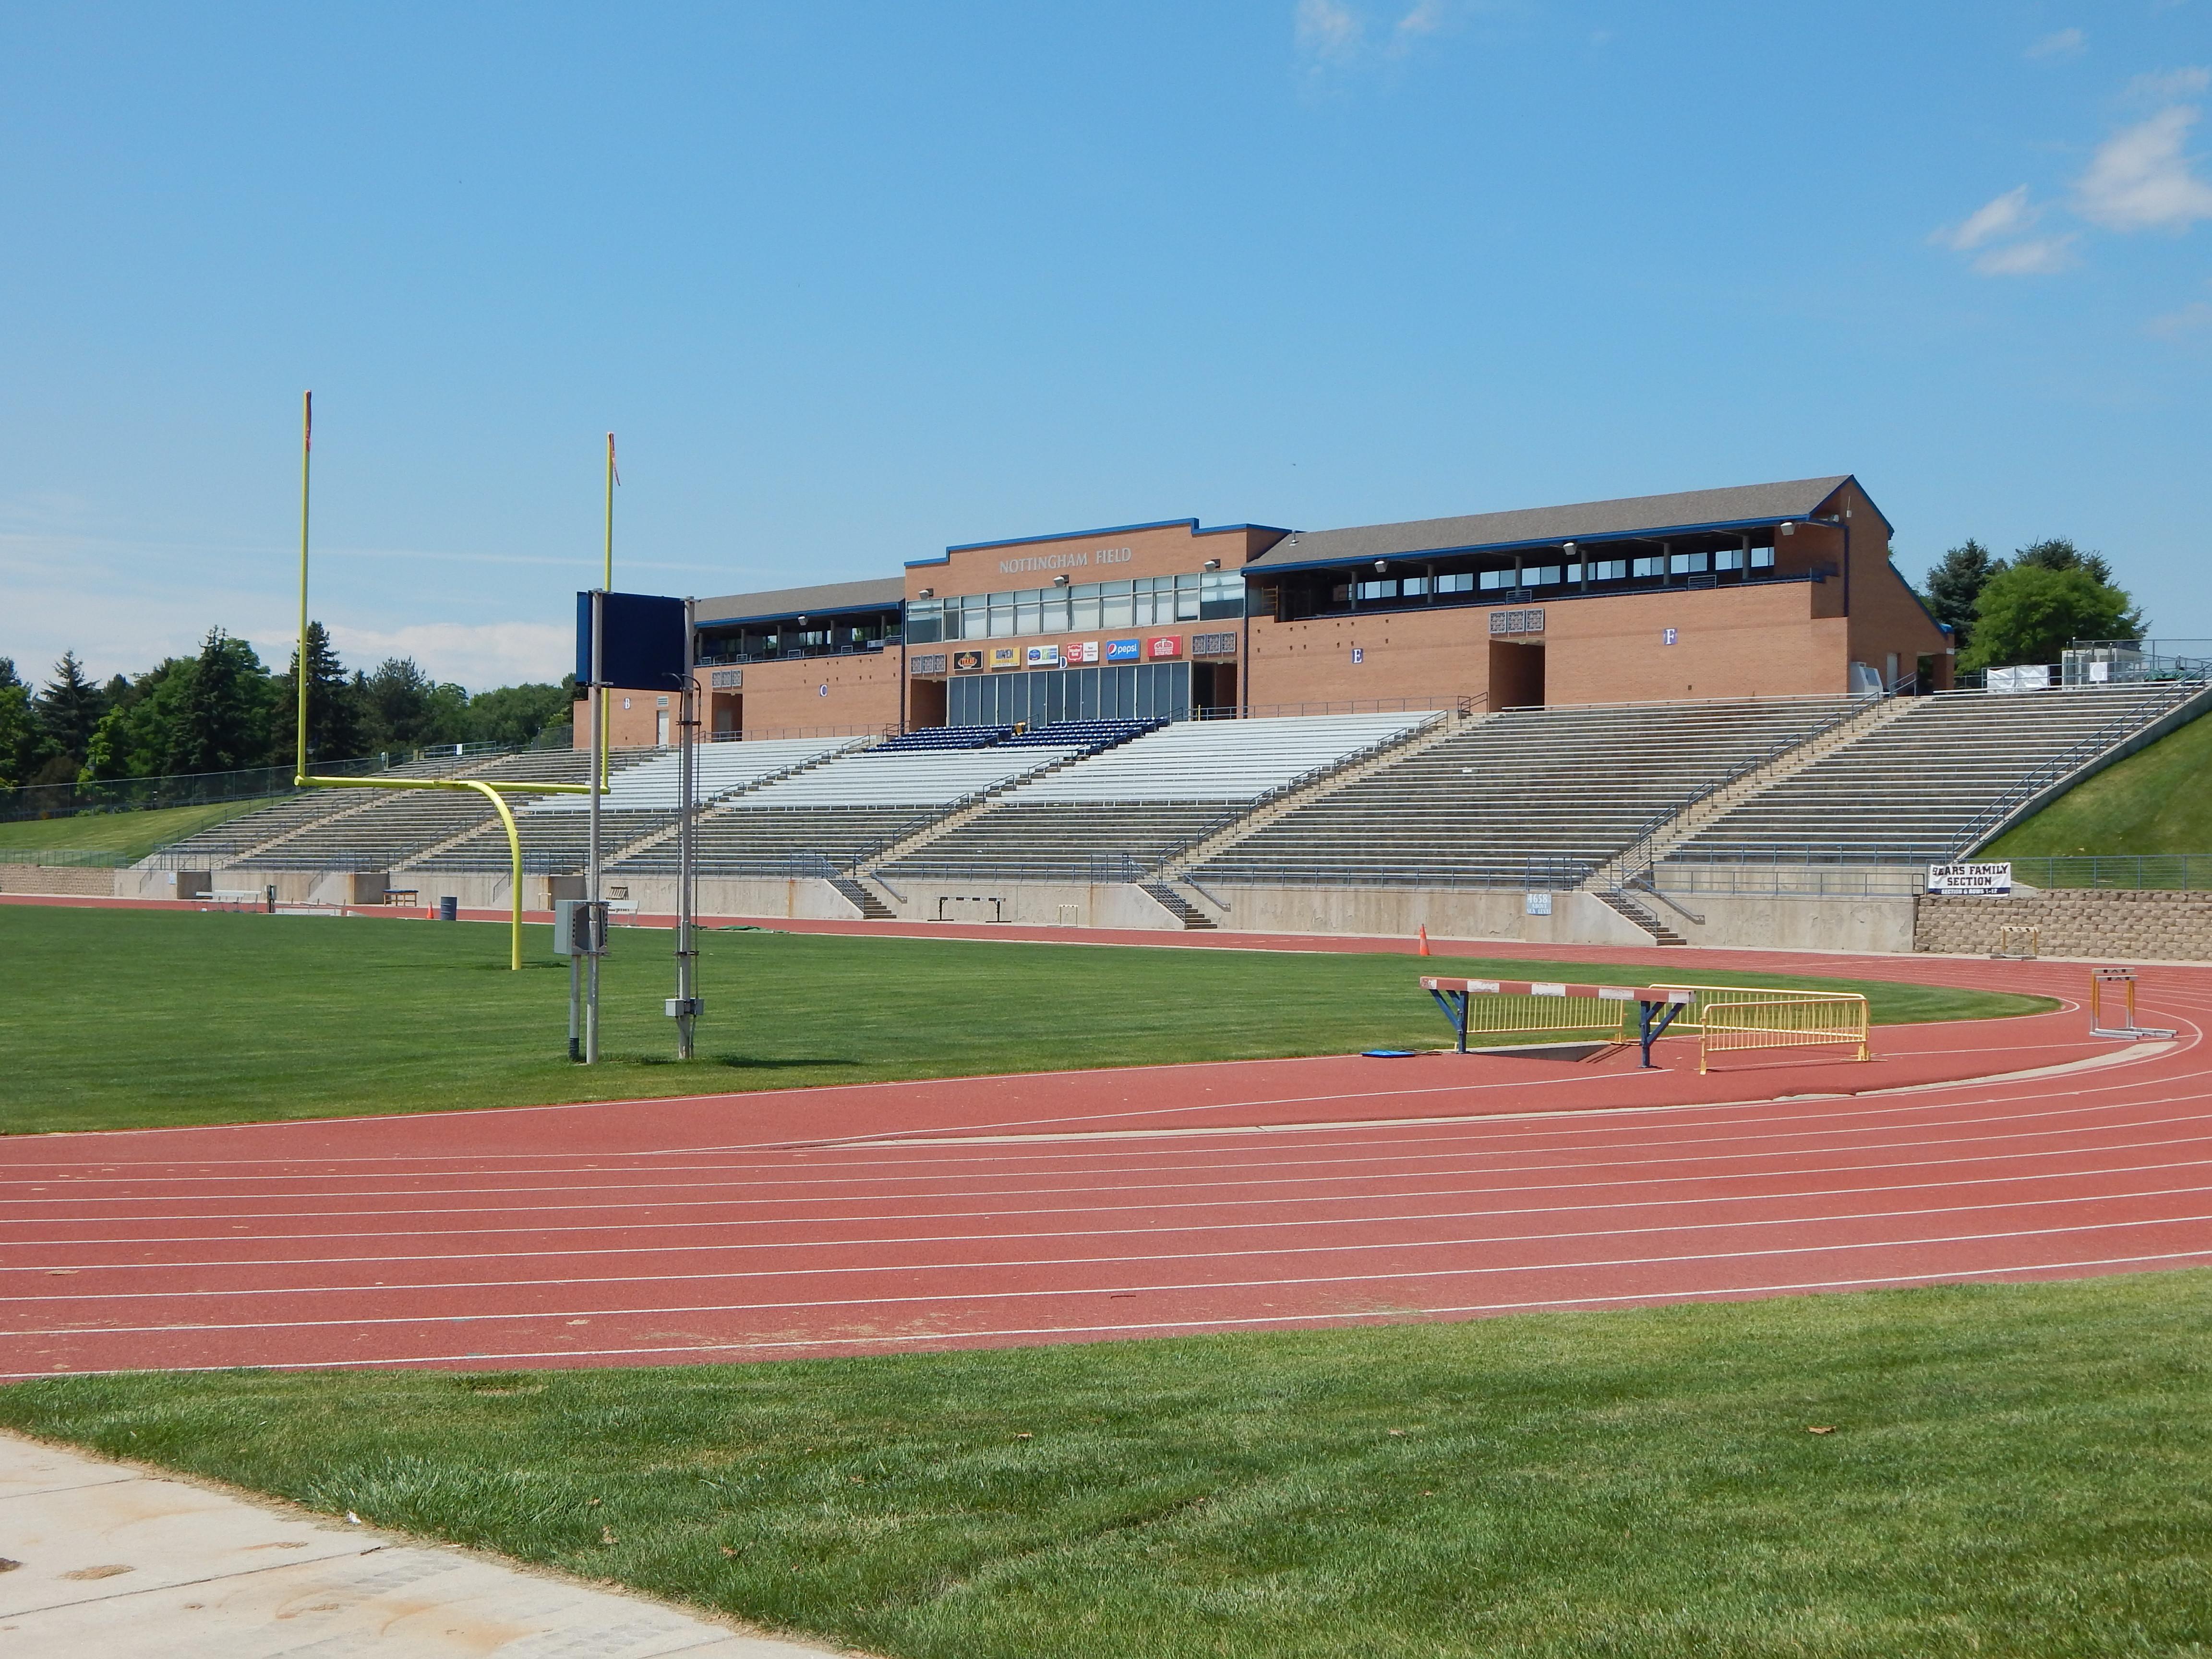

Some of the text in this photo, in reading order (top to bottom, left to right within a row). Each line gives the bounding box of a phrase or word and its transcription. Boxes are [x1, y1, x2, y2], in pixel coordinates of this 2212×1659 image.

[1000, 547, 1131, 573] NOTTINGHAM FIELD
[1666, 629, 1675, 644] F
[1118, 643, 1137, 655] pepsi
[1354, 649, 1362, 663] E
[1059, 656, 1067, 669] D
[2090, 663, 2105, 680] G
[820, 685, 827, 697] C
[625, 698, 630, 709] B
[1933, 865, 2008, 875] BEARS FAMILY
[1948, 877, 1992, 886] SECTION
[1527, 894, 1548, 903] 4658
